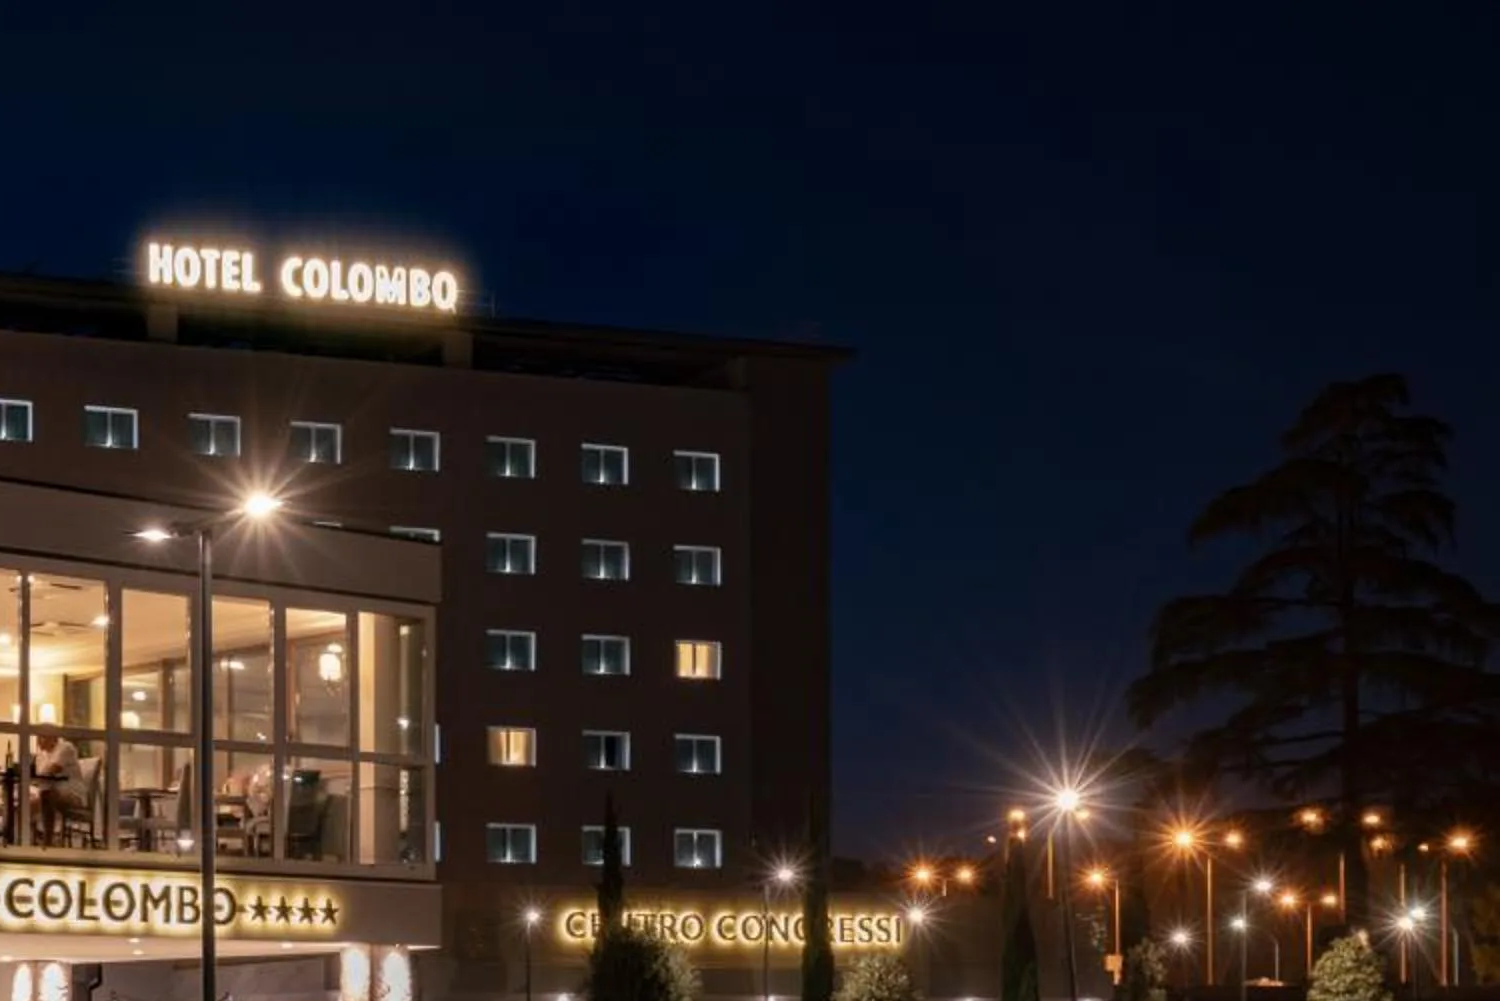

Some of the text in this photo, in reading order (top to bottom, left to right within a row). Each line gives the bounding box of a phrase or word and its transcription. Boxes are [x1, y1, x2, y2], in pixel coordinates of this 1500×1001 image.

[148, 242, 458, 312] HOTEL COLOMBO
[3, 876, 237, 926] COLOMBO
[565, 911, 705, 941] CETRO
